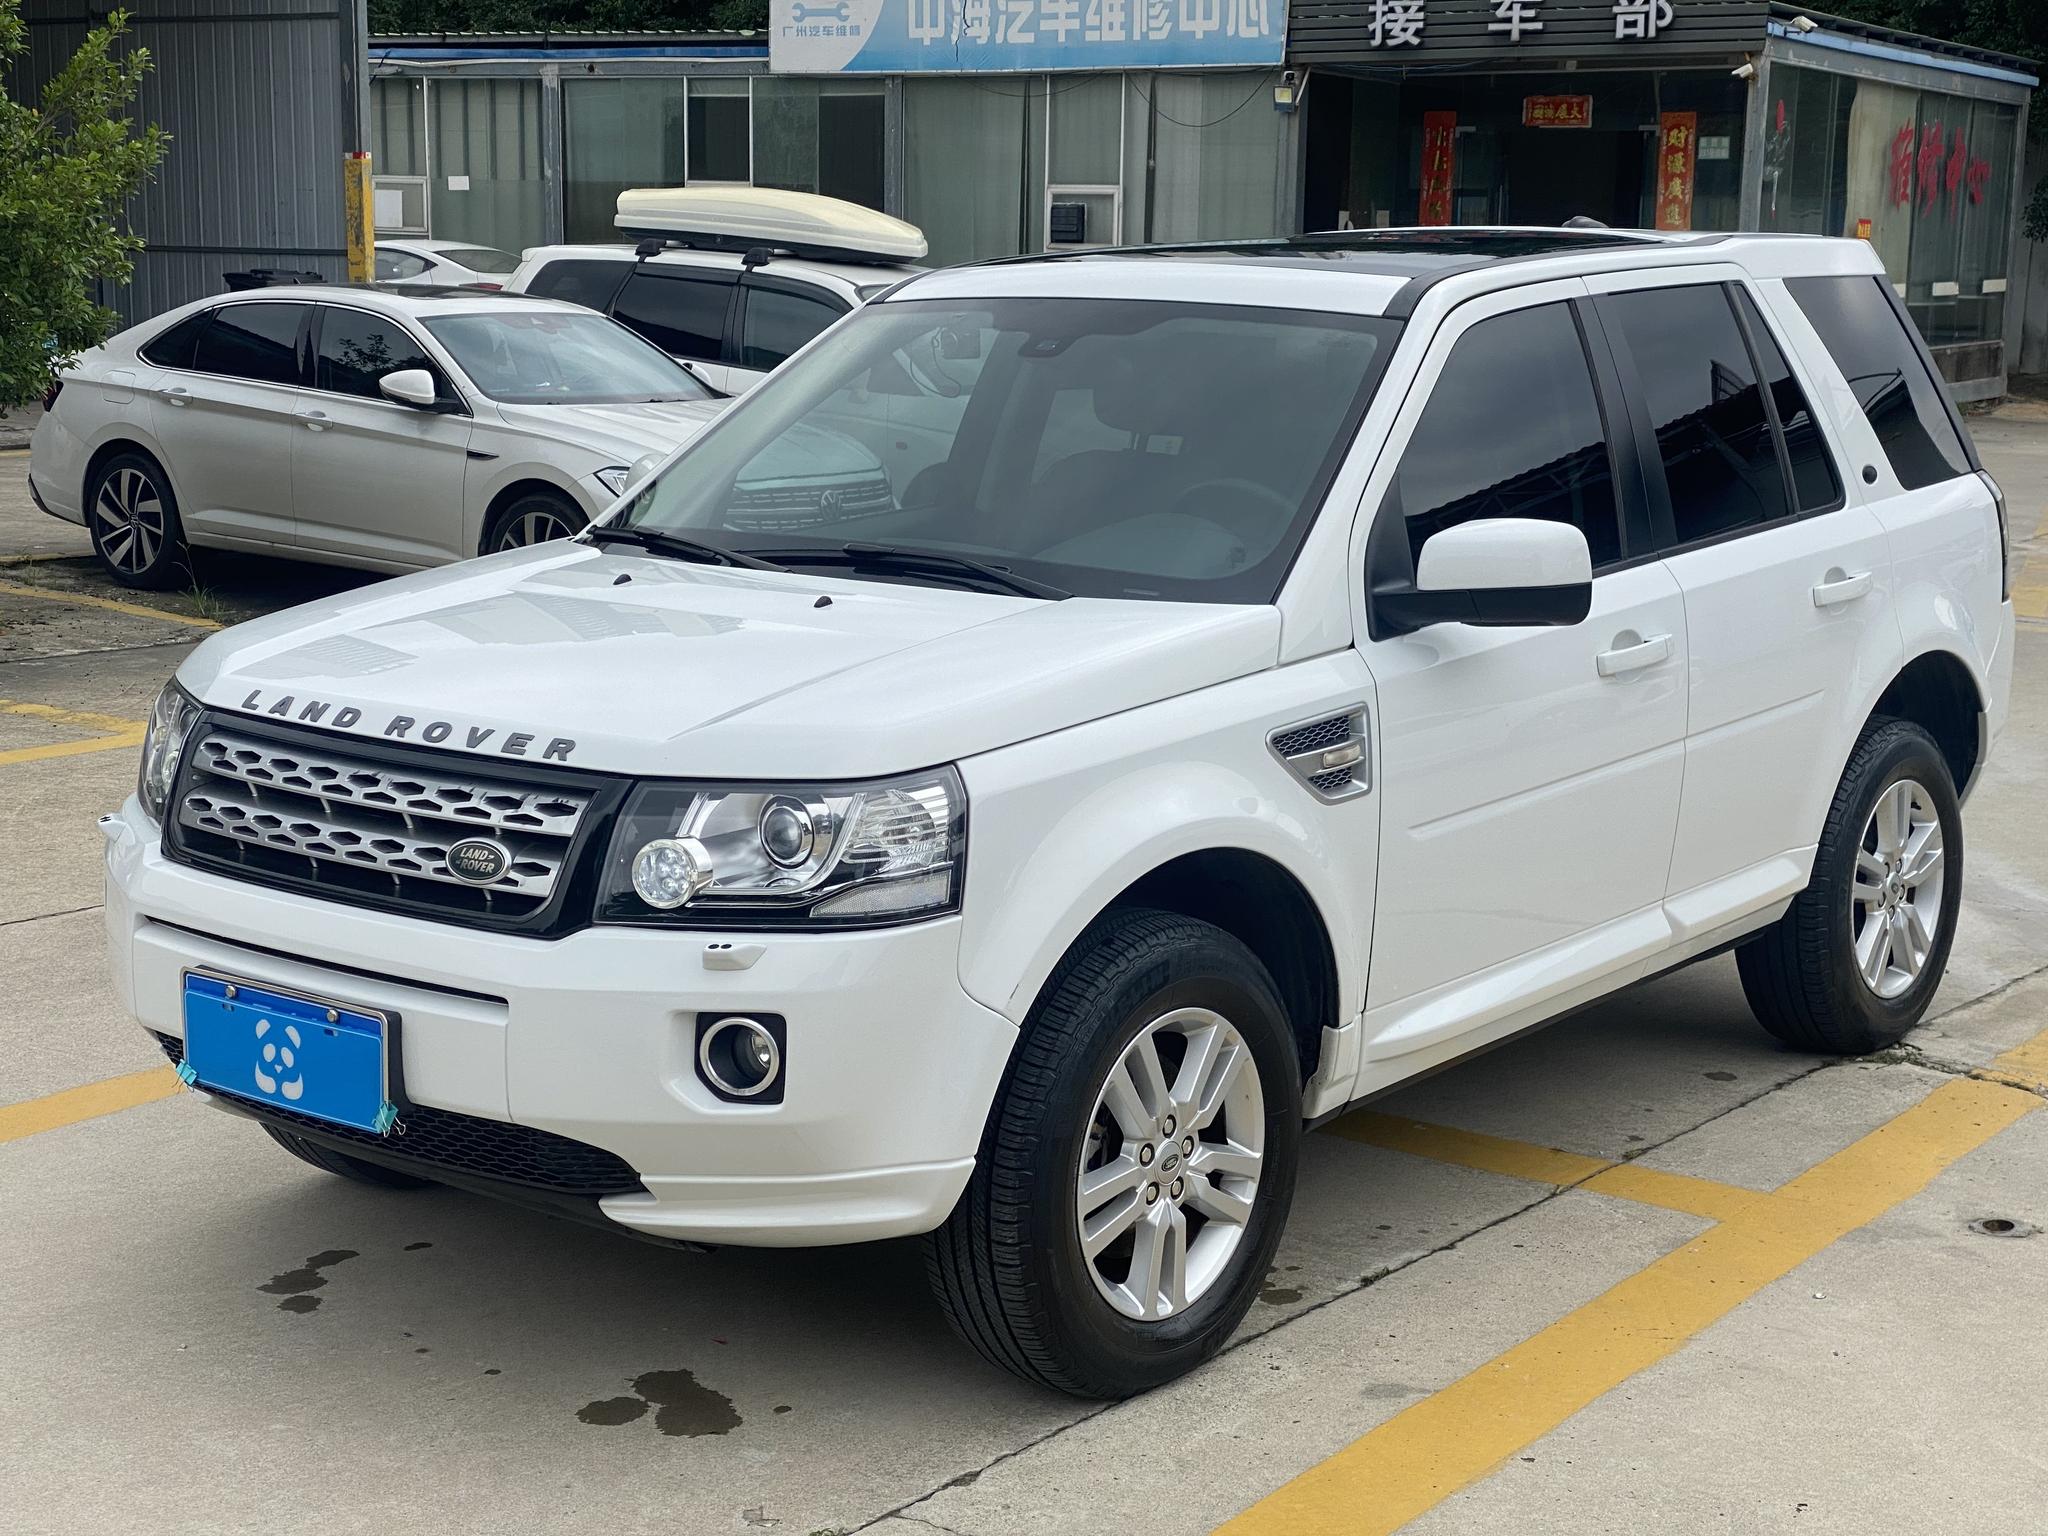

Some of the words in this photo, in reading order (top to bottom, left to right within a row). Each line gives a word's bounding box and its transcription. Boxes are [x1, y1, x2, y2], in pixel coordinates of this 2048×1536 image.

[241, 690, 361, 728] LAND
[384, 715, 577, 761] ROVER
[460, 858, 495, 873] ROVER
